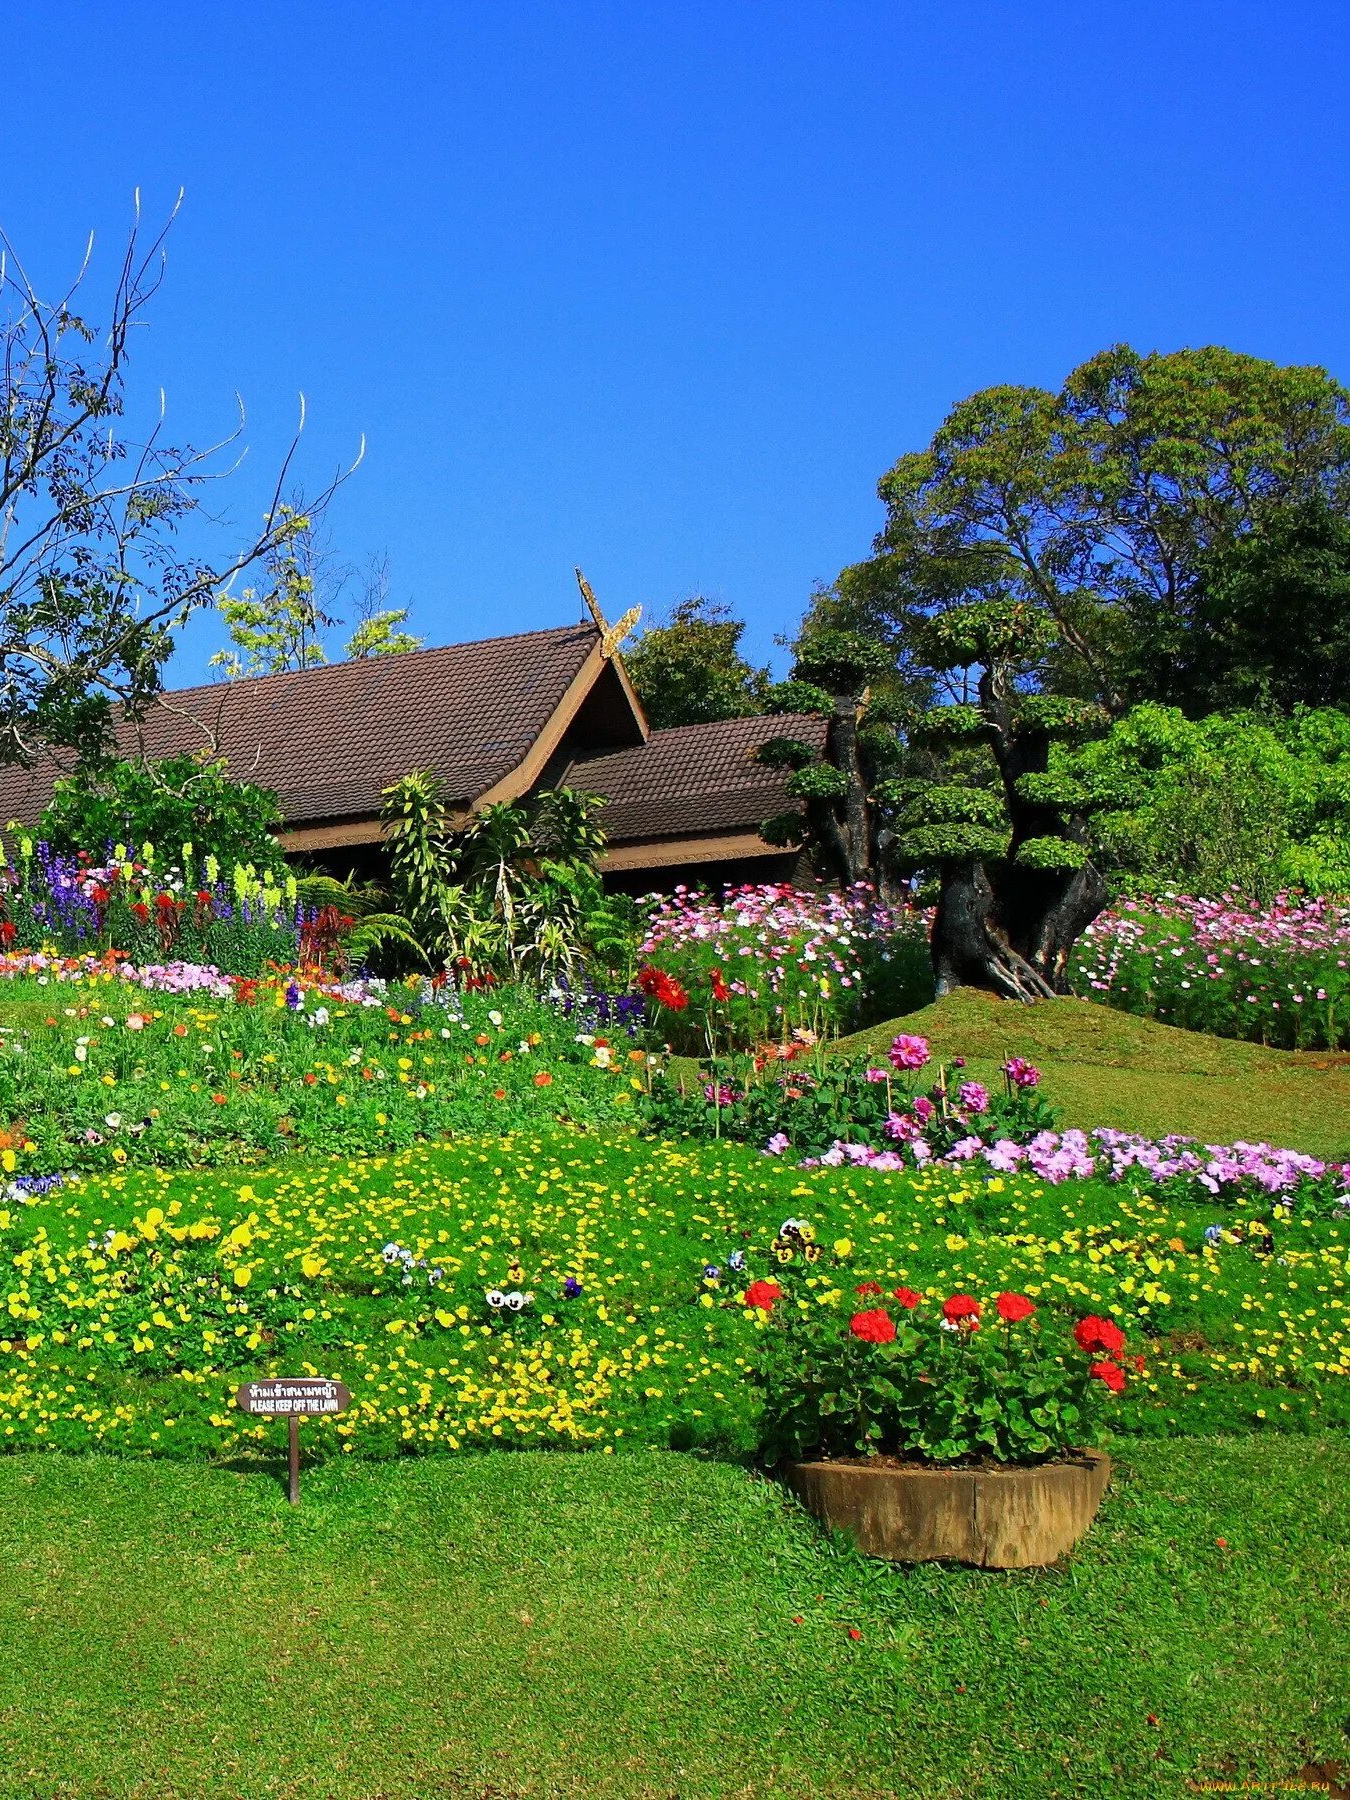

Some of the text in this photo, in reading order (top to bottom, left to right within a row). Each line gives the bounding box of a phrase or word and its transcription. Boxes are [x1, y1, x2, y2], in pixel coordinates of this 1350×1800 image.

[249, 1383, 337, 1398] ห้ามเข้าสนามหญ้า
[250, 1399, 338, 1412] PLEASE KEEP OFF THE LAWN
